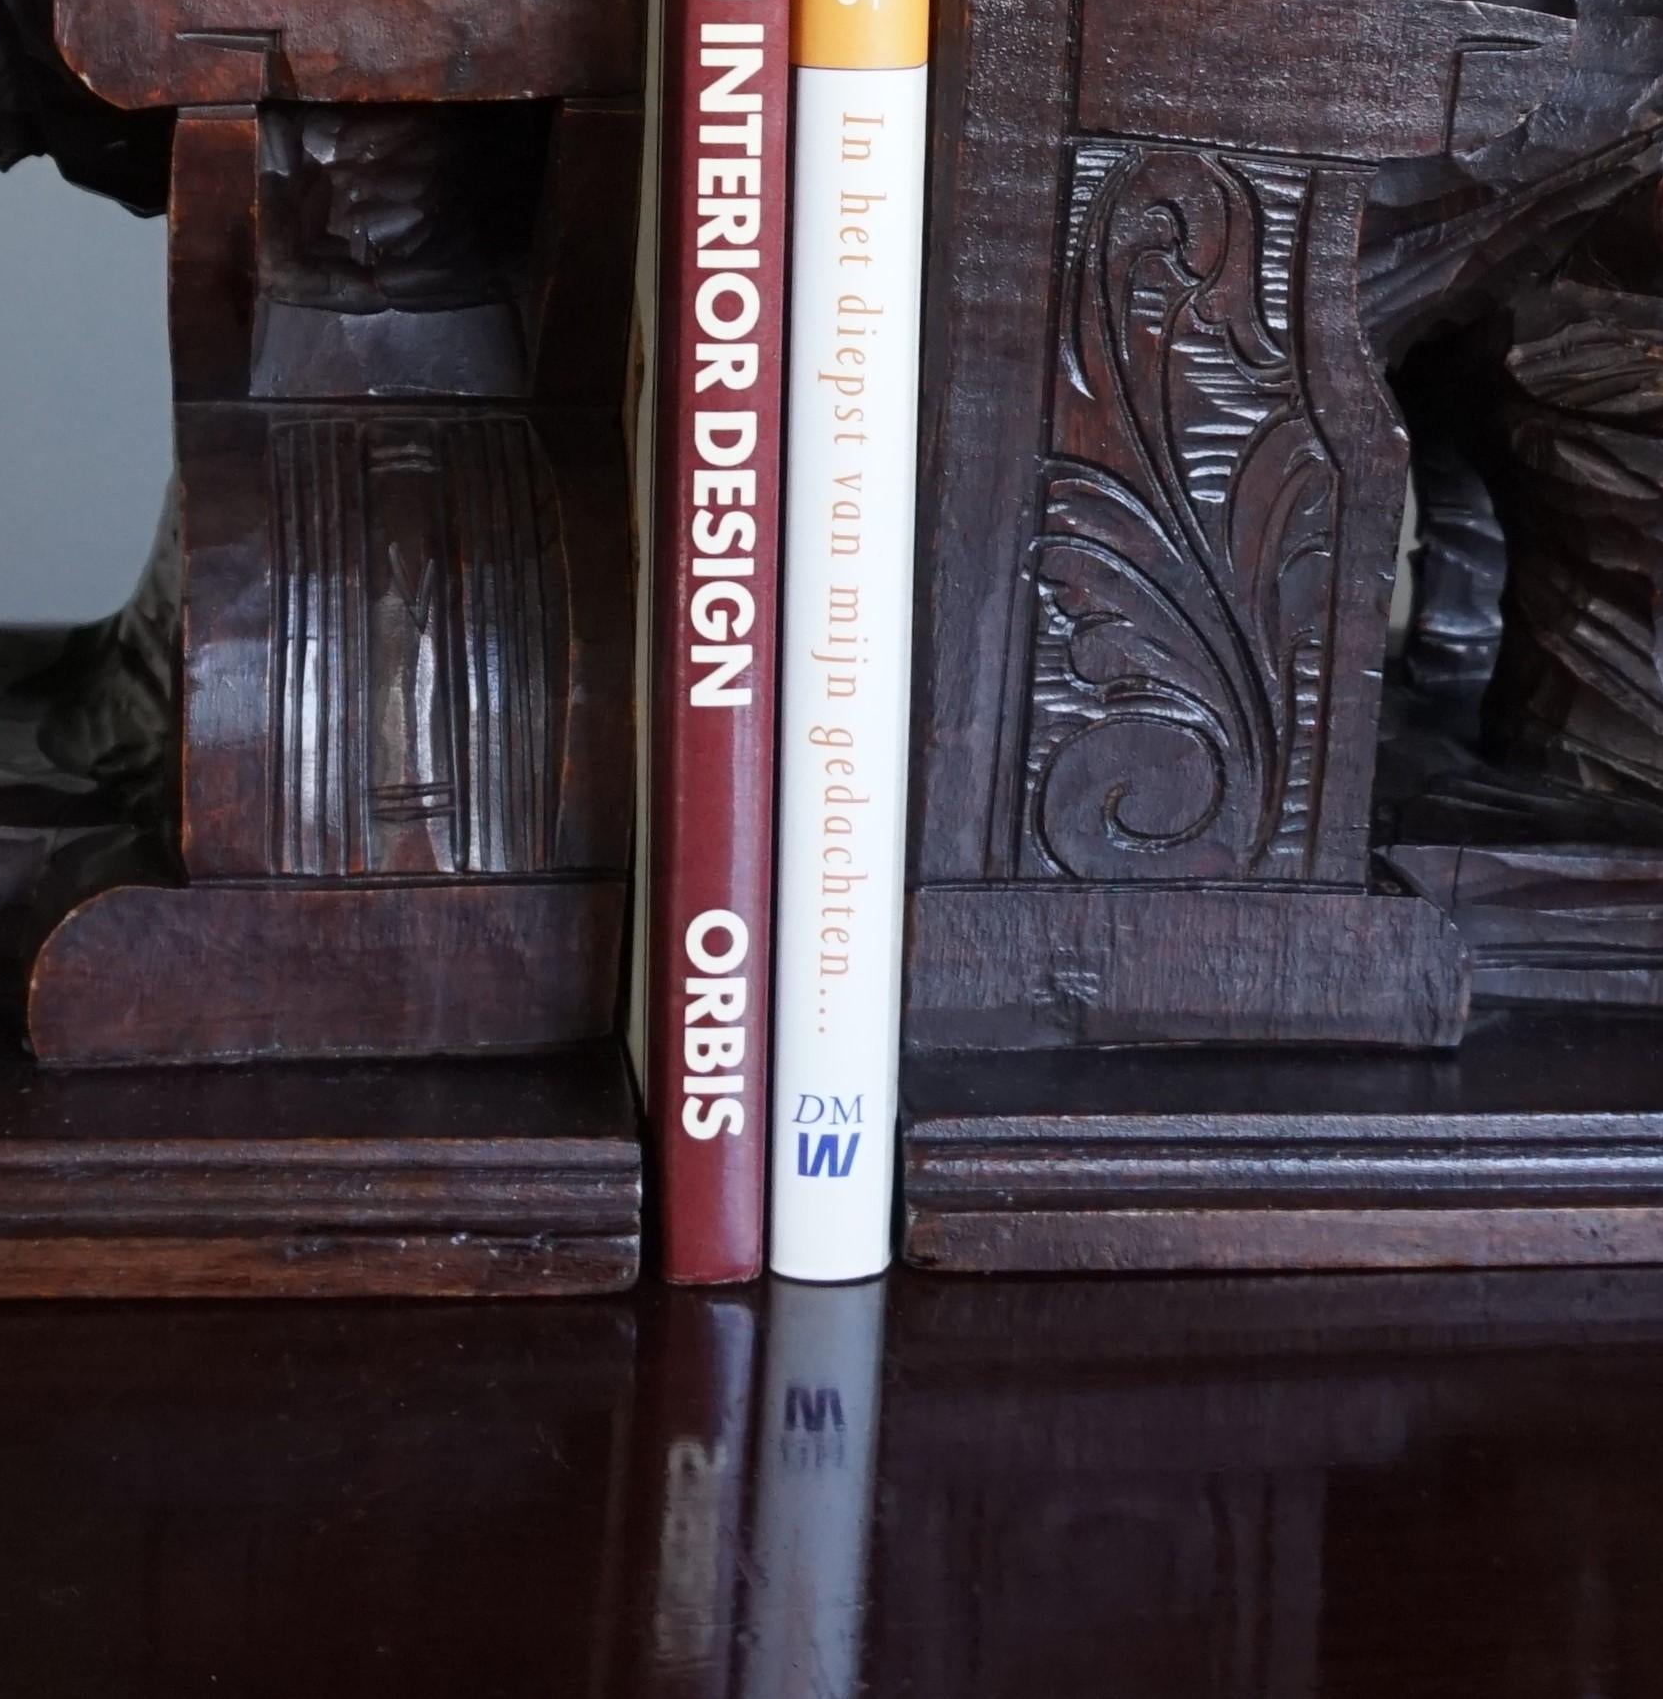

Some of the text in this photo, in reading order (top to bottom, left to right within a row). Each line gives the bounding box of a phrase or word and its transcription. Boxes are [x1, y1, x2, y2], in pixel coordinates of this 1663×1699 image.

[695, 23, 764, 394] INTERIOR
[690, 411, 757, 708] DESIGN
[808, 112, 888, 1033] In het diepst van mijn gedachten...
[681, 909, 749, 1141] ORBIS
[792, 1093, 864, 1125] DM
